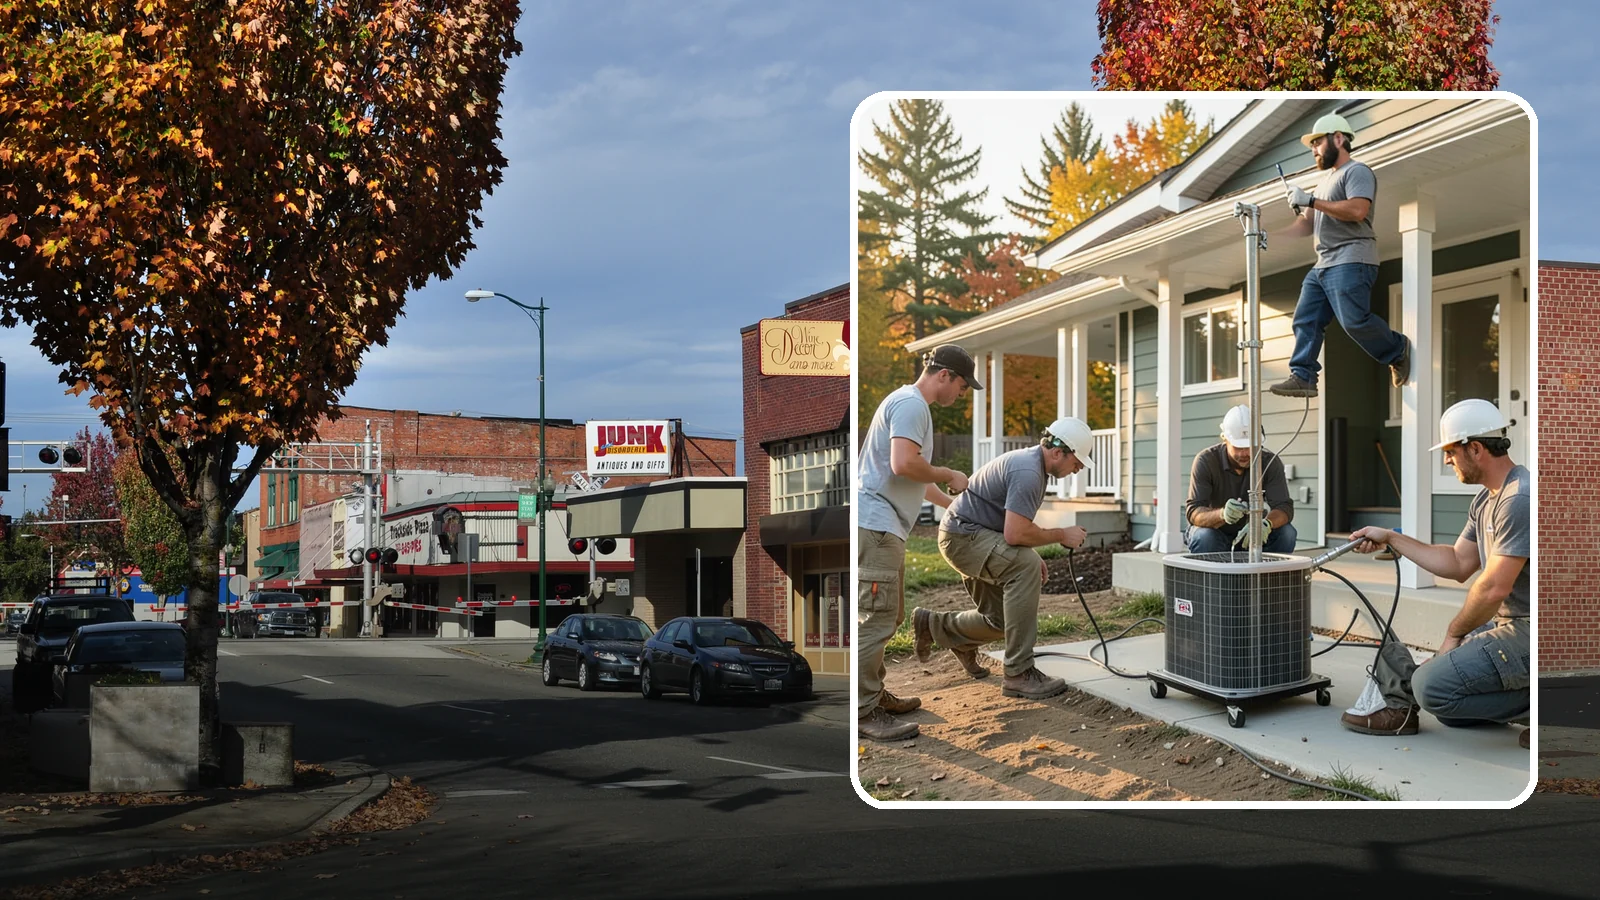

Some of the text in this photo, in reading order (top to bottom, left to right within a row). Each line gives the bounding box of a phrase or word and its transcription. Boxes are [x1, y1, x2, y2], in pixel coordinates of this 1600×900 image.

[765, 327, 831, 366] Decor
[595, 425, 665, 458] JUNK
[607, 446, 646, 454] DISORDERLY
[597, 460, 666, 470] ANTIQUES AND GIFTS
[414, 519, 429, 535] Pizza
